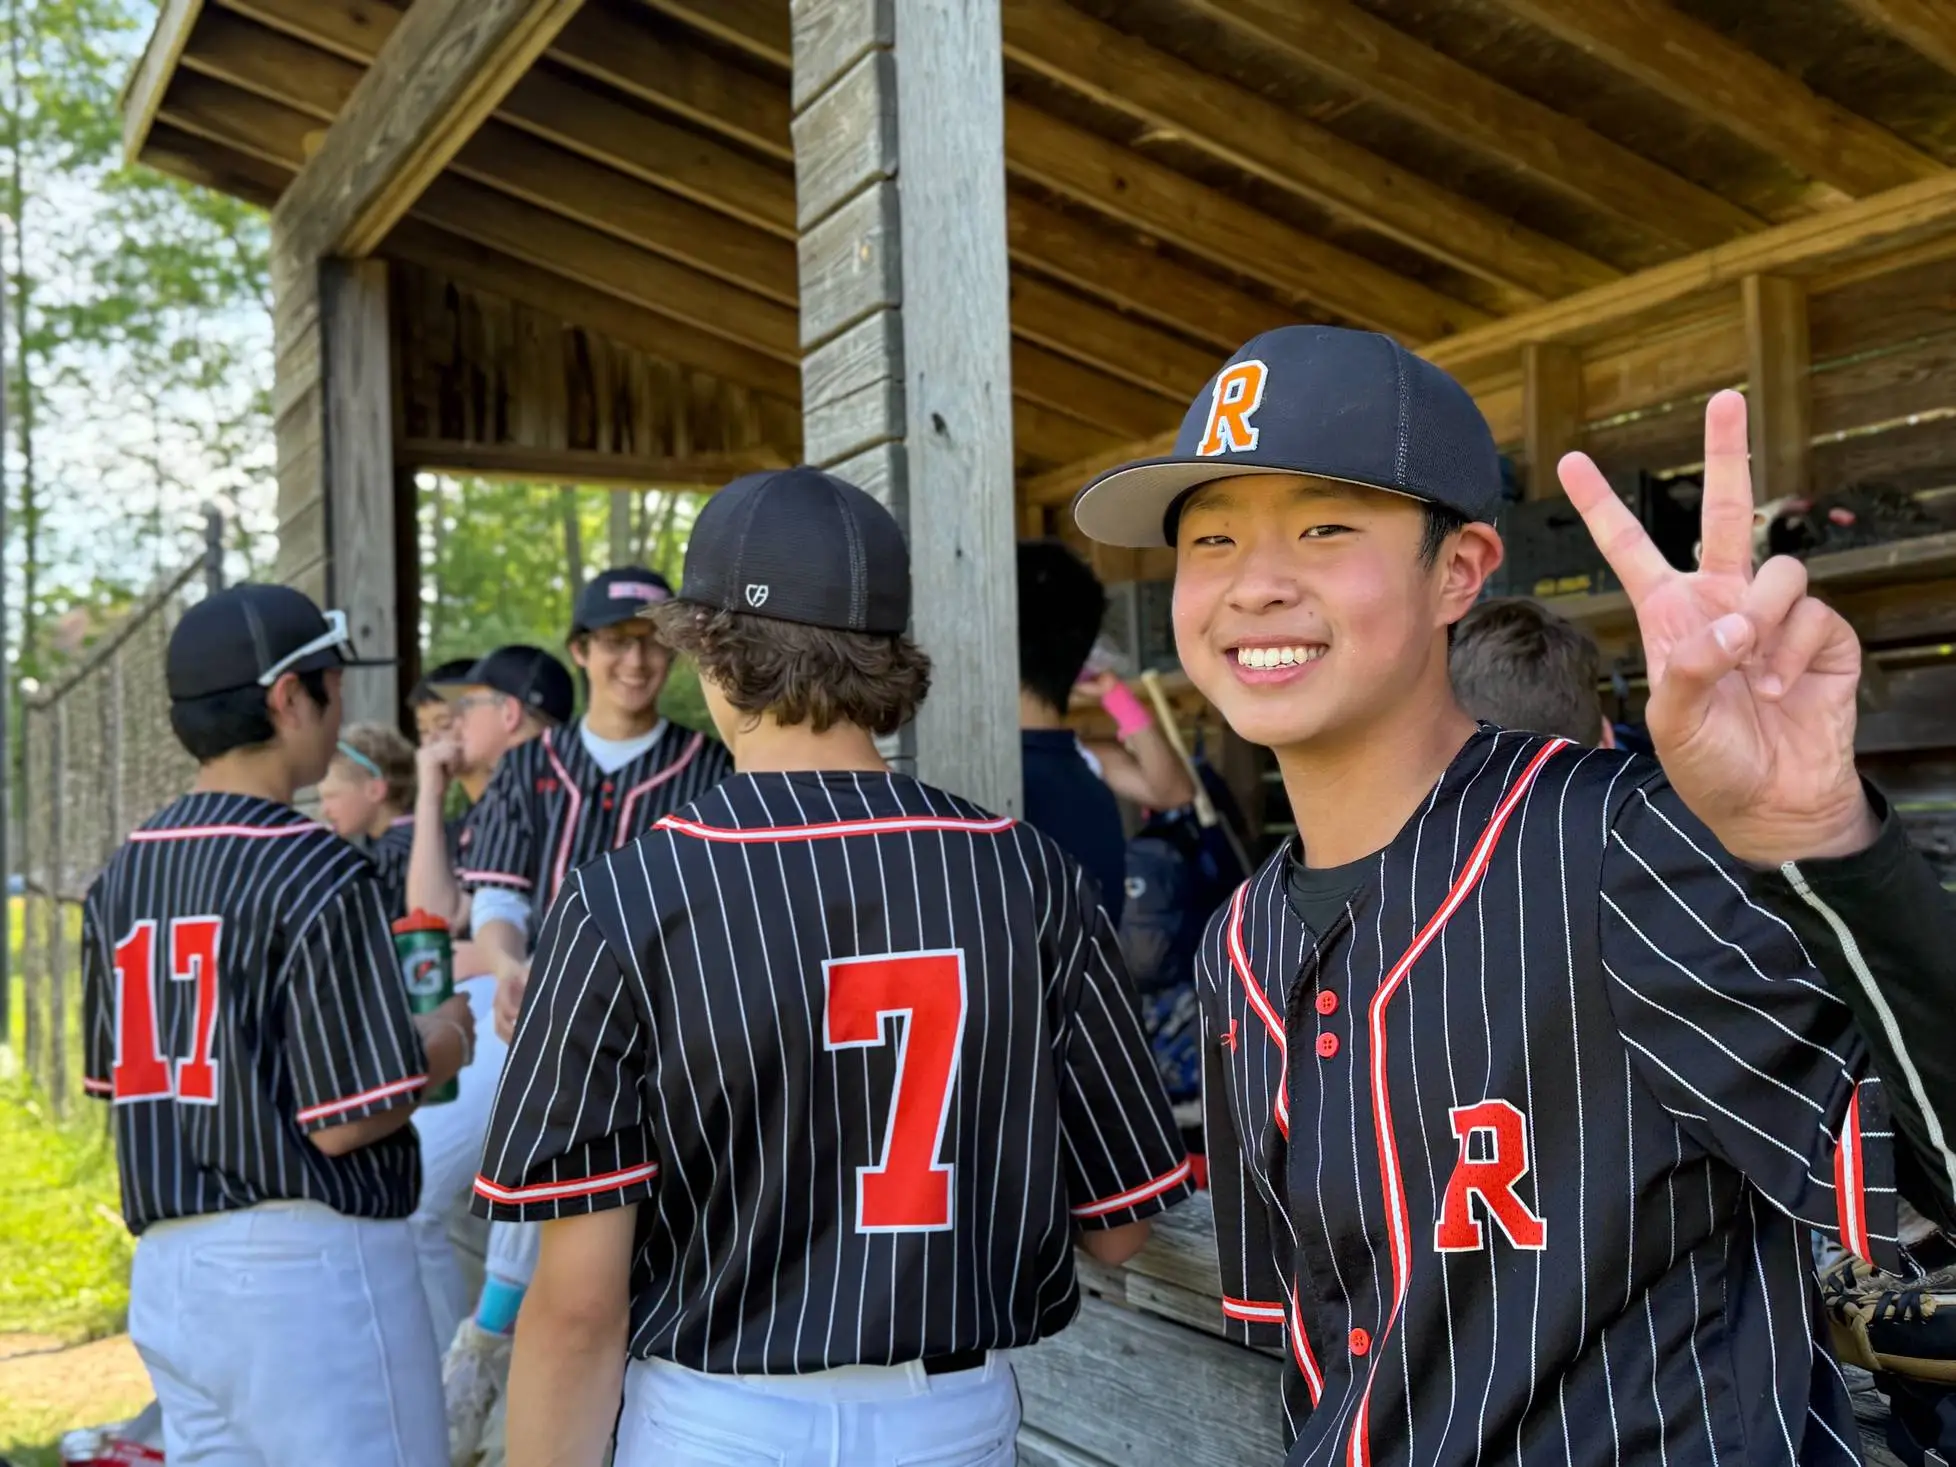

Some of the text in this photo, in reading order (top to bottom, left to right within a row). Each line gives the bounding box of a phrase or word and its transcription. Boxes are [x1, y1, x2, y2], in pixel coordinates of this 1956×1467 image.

[1196, 360, 1268, 456] R
[112, 915, 223, 1105] 17
[403, 949, 442, 995] G
[821, 948, 968, 1234] 7
[1434, 1099, 1547, 1252] R
